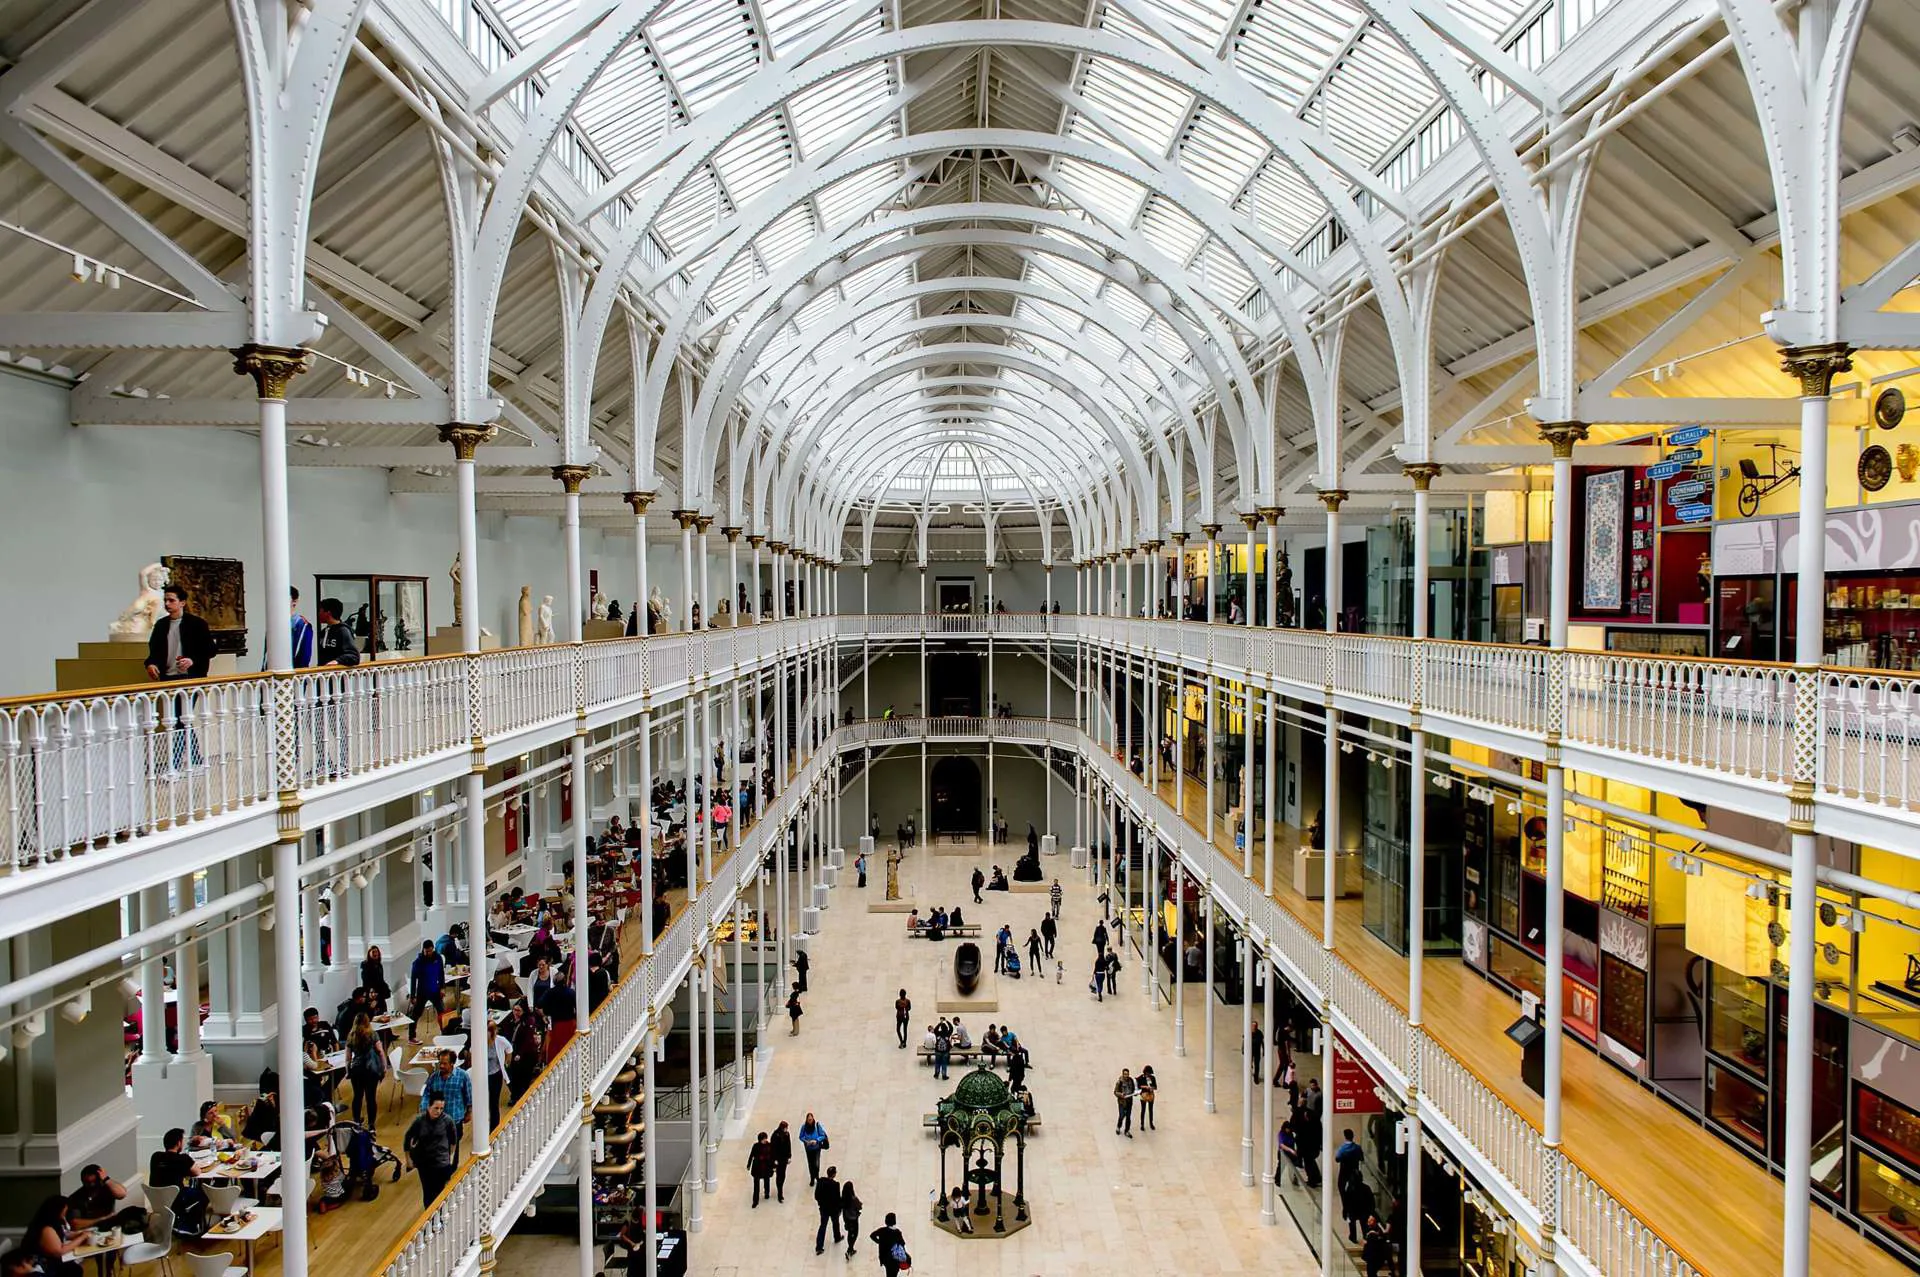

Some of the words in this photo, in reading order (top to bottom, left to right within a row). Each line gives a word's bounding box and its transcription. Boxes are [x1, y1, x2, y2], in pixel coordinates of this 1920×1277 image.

[1653, 466, 1673, 475] GARVE
[1671, 484, 1704, 496] STONEHAVEN
[1678, 510, 1692, 518] NORTH
